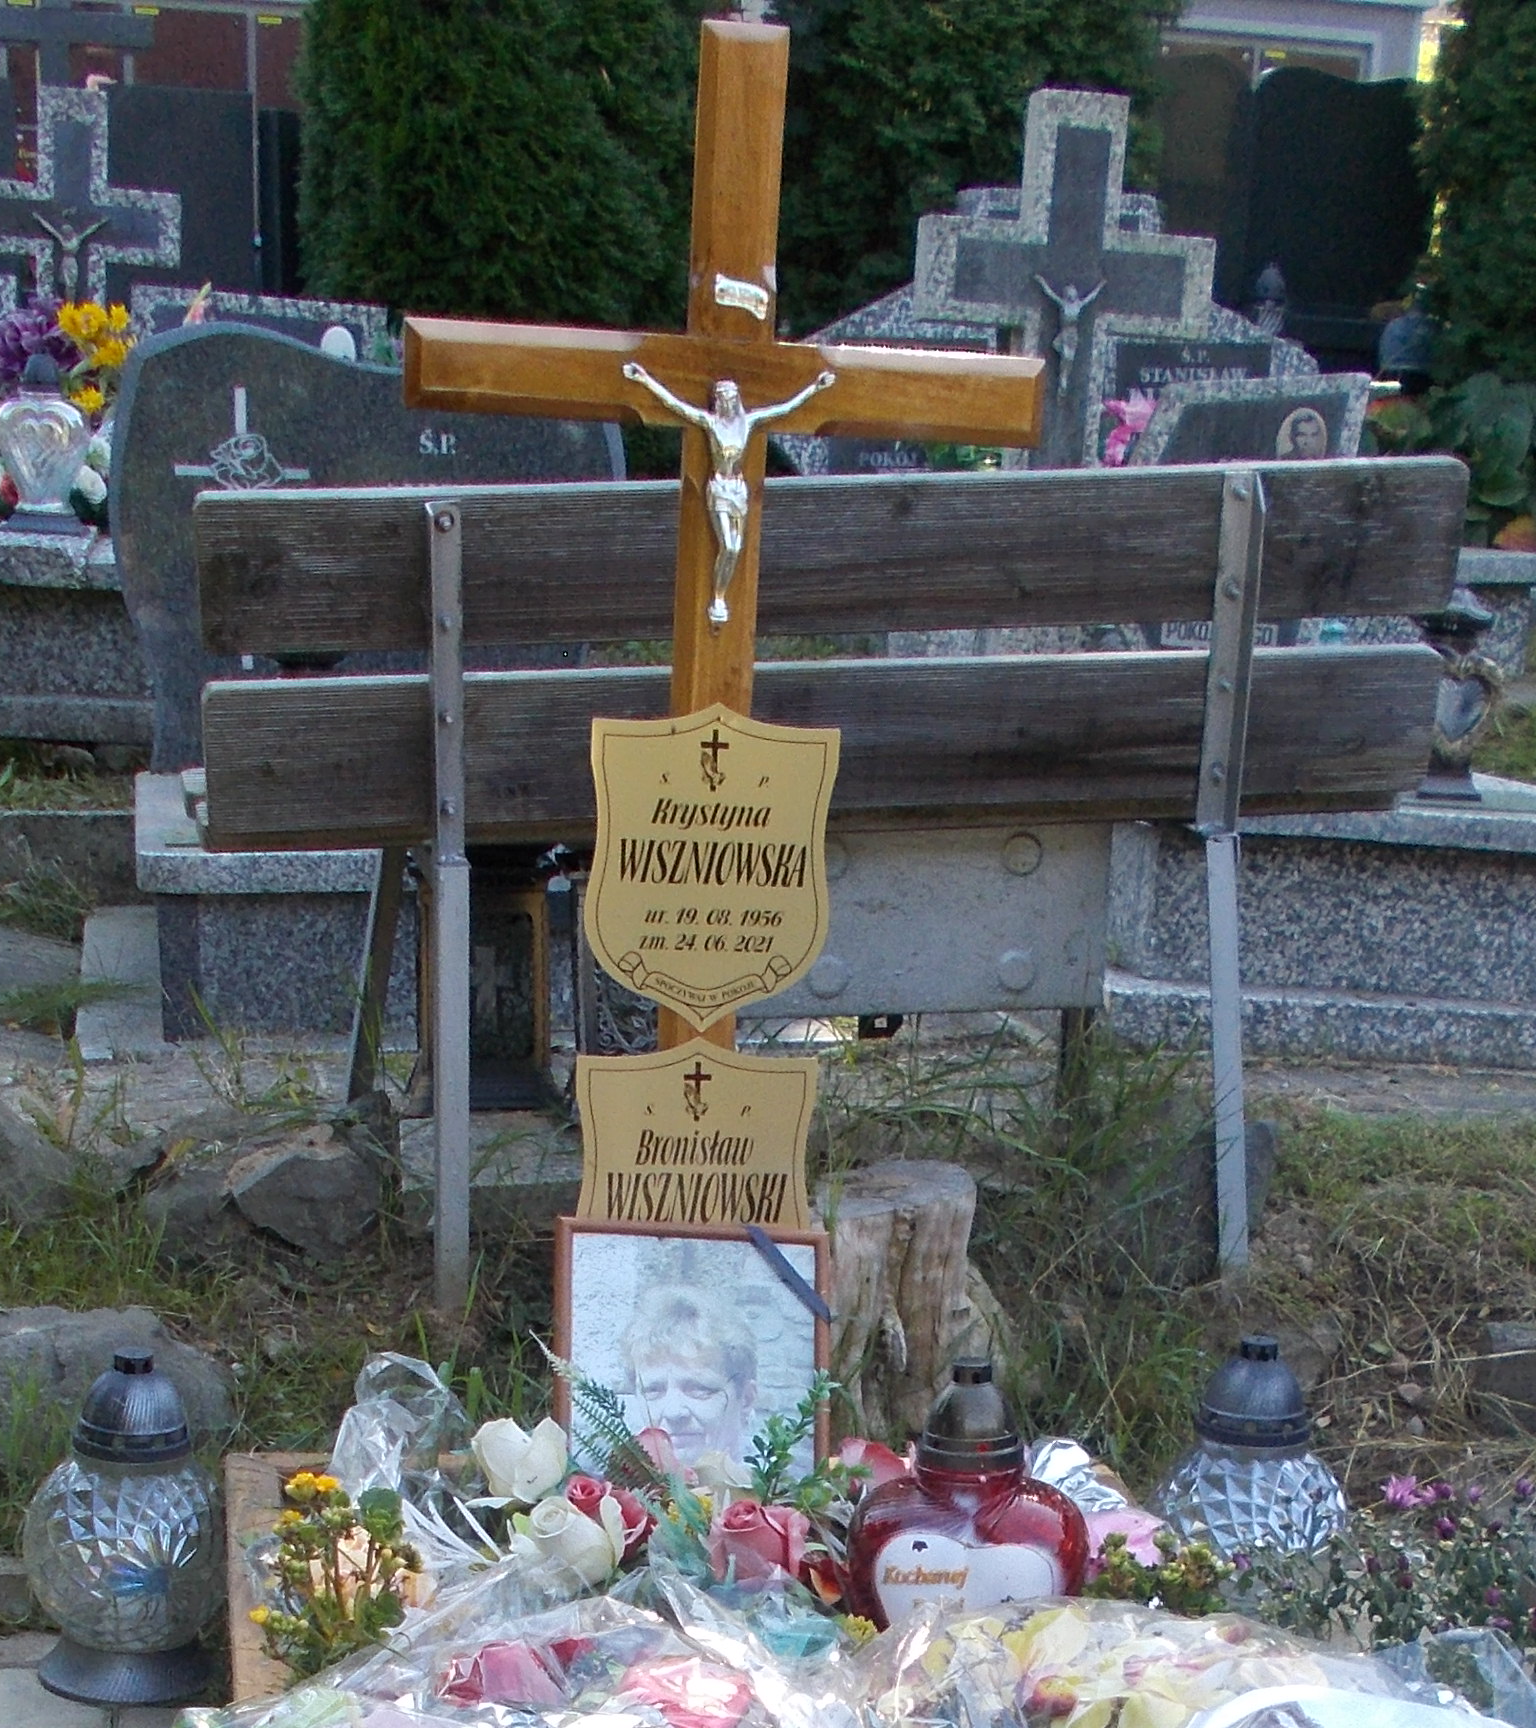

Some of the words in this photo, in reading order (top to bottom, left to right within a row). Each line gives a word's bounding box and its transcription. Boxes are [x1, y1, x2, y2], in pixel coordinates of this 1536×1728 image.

[651, 798, 772, 832] Krystyna
[618, 837, 808, 889] WISZNIOWSKA
[644, 909, 668, 924] ur.
[675, 907, 699, 925] 19.
[706, 908, 733, 926] 08.
[740, 909, 784, 928] 1956
[639, 935, 666, 950] zm.
[674, 933, 697, 951] 24.
[704, 935, 726, 951] 06.
[734, 934, 774, 953] 2021
[634, 1128, 756, 1166] Bronisław
[605, 1172, 789, 1224] WISZNIOWSKI
